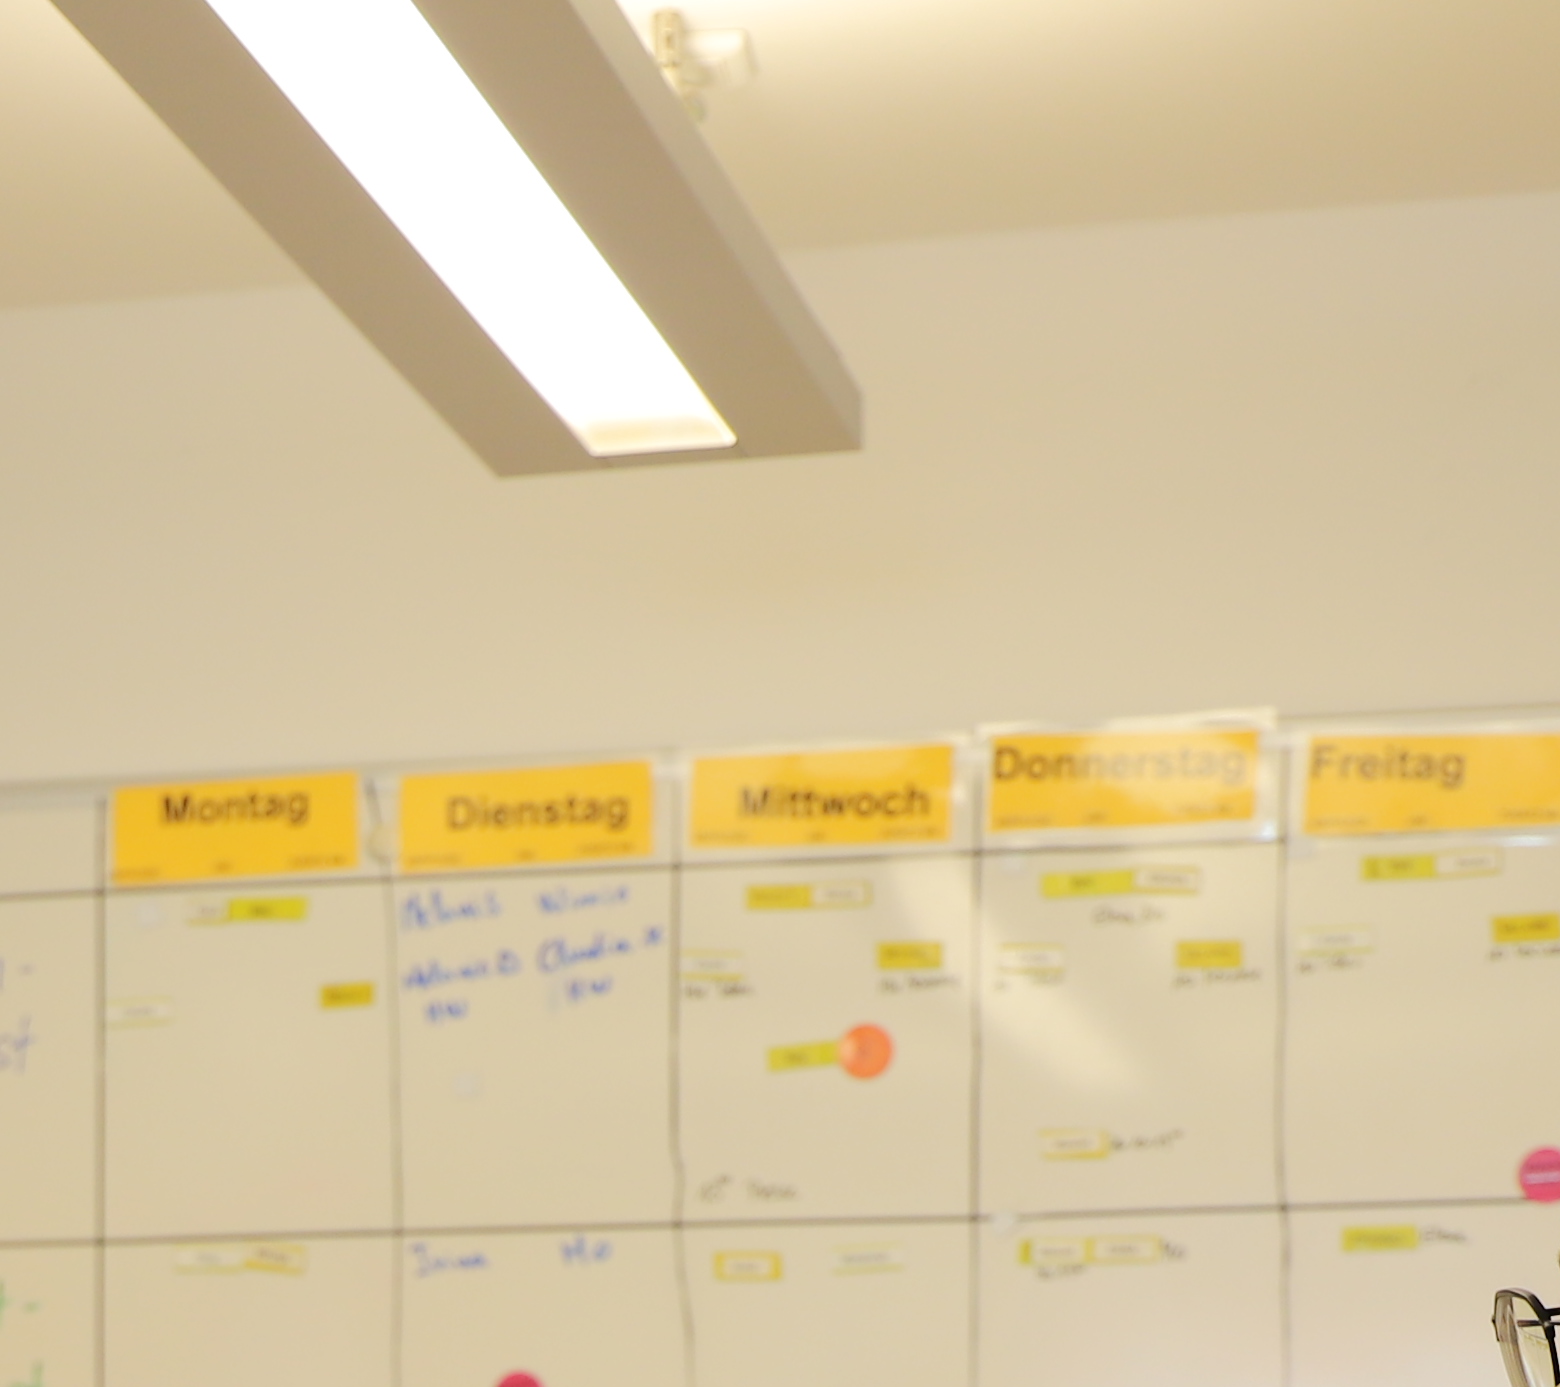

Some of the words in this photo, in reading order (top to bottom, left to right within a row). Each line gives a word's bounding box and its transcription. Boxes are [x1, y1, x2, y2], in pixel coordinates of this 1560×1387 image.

[992, 745, 1248, 788] Donnerstag
[1310, 744, 1466, 788] Freitag
[160, 788, 310, 829] Montag
[446, 794, 631, 834] Dienstag
[738, 783, 931, 821] Mittwoch
